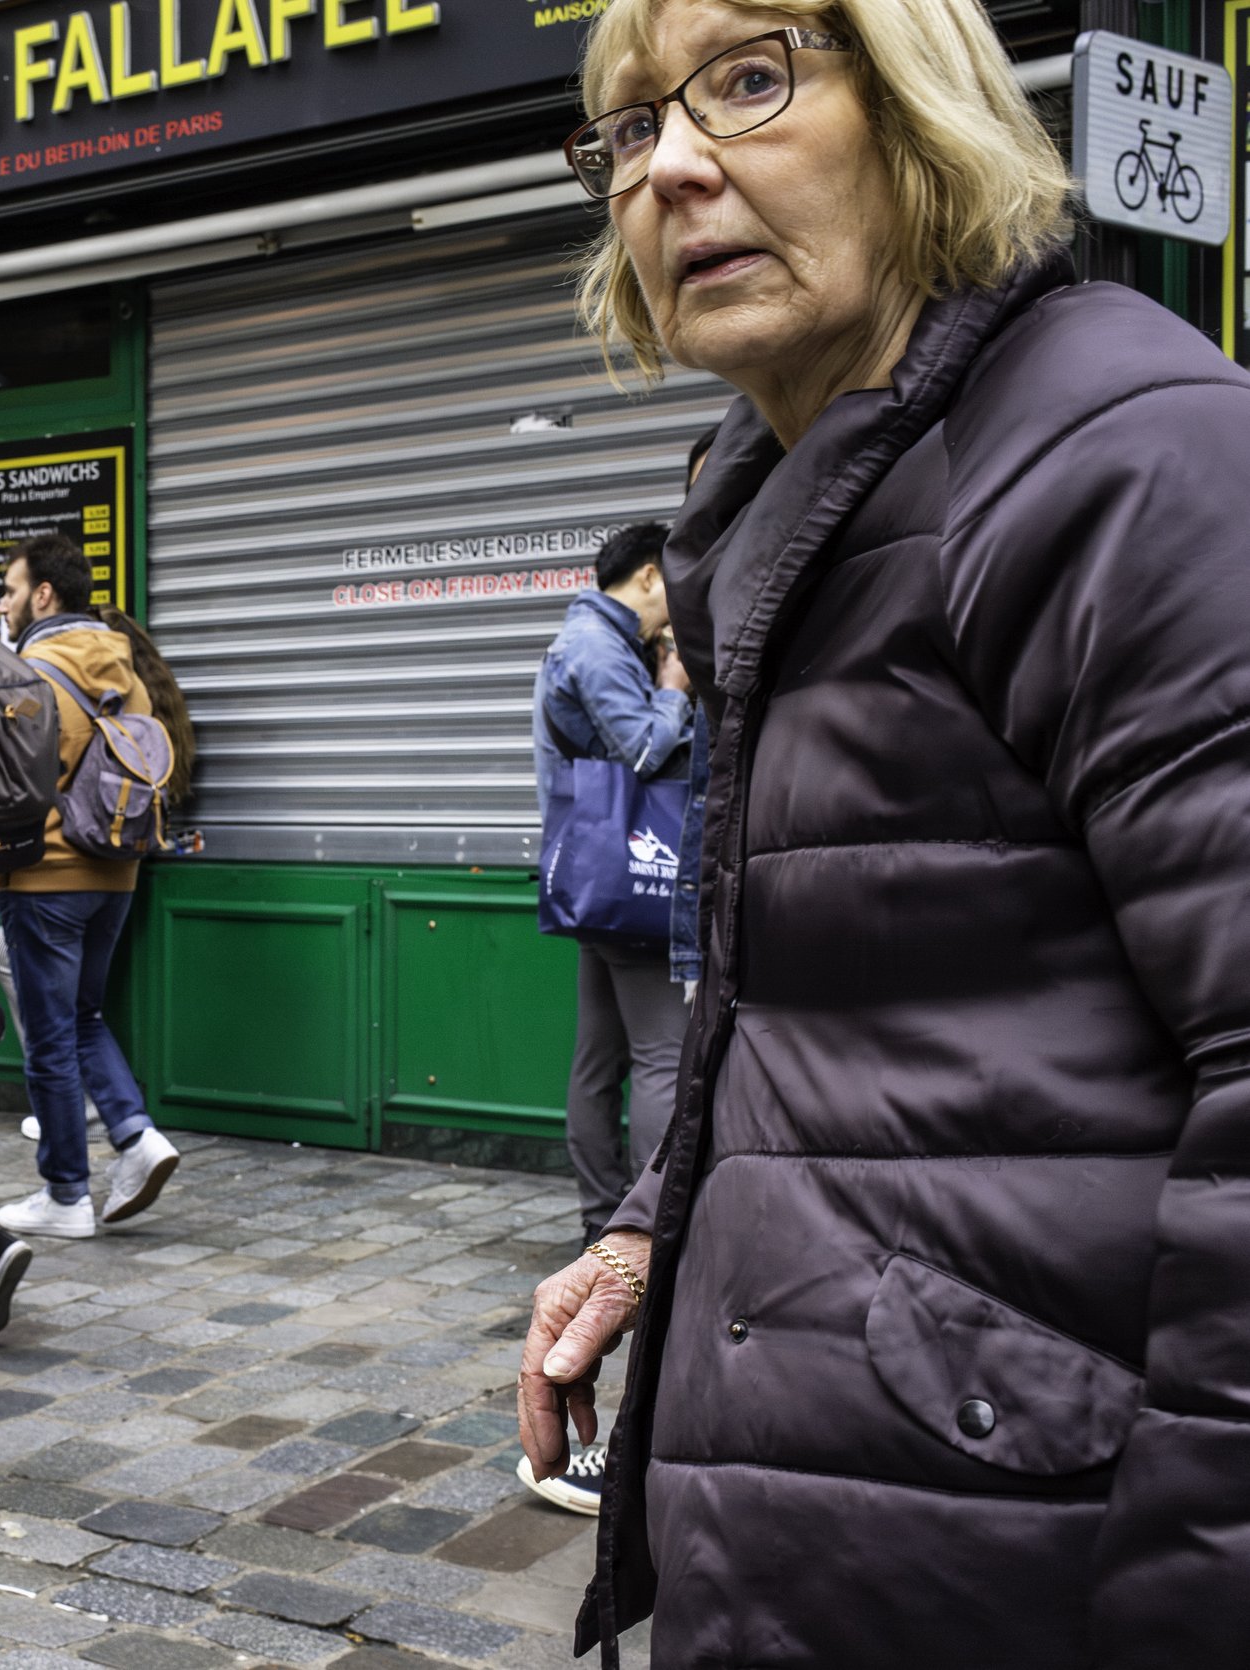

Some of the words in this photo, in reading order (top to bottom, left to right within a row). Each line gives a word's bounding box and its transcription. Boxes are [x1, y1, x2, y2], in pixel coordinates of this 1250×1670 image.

[1116, 52, 1209, 116] SAUF
[15, 150, 41, 171] DU
[45, 131, 130, 166] BETH-DIN
[134, 124, 161, 147] DE
[165, 111, 223, 140] PARIS
[9, 461, 100, 488] SANDWICHS
[421, 539, 462, 562] LES
[464, 527, 585, 558] VENDREDI
[333, 581, 406, 606] CLOSE
[409, 578, 441, 601] ON
[445, 571, 528, 598] FRIDAY
